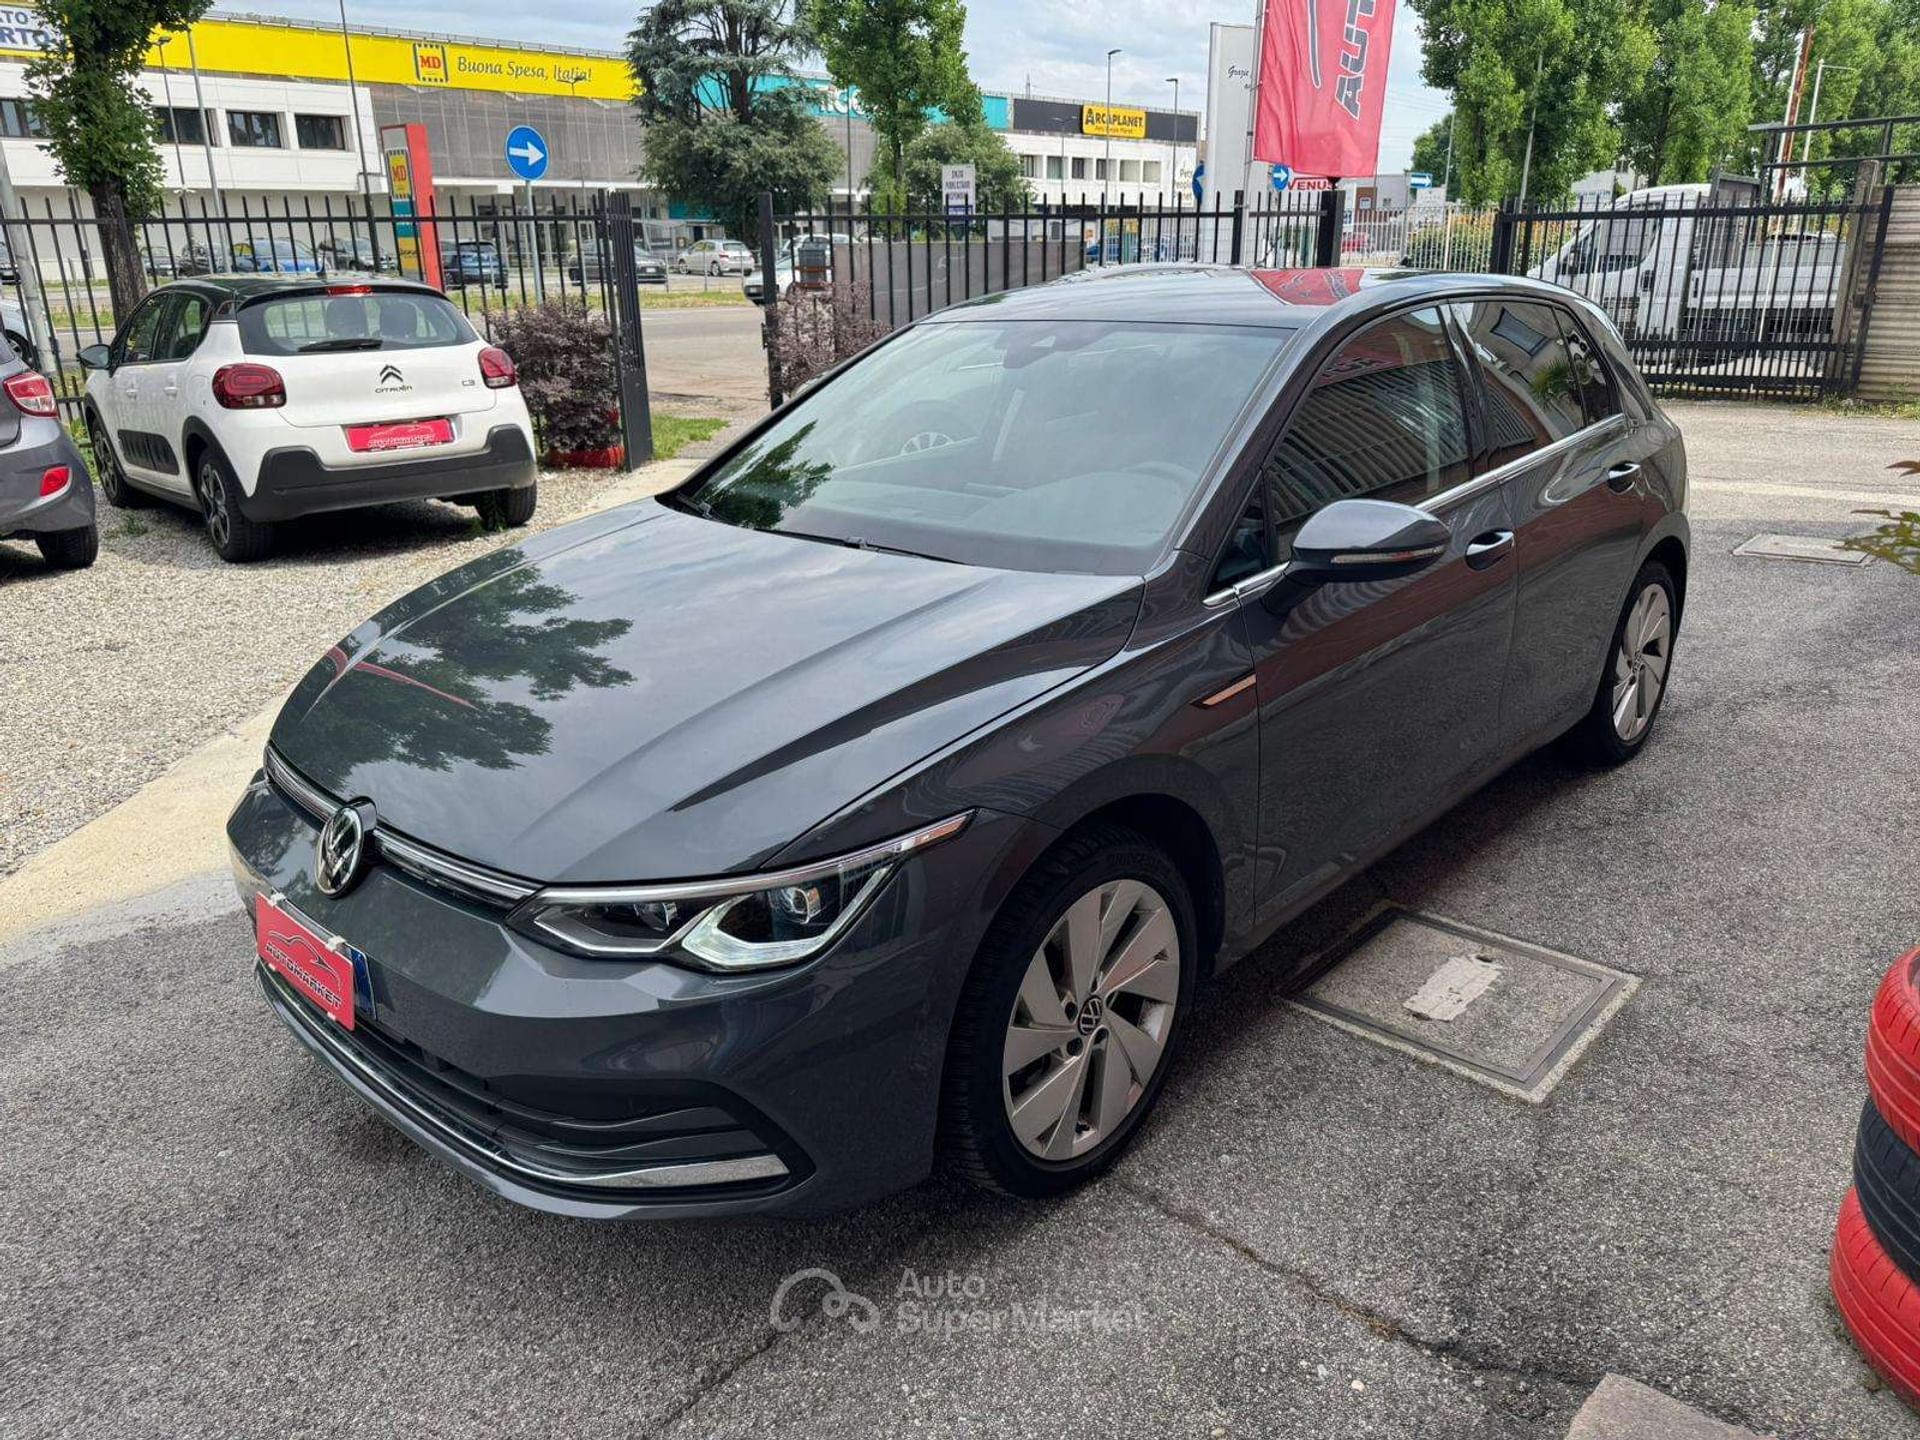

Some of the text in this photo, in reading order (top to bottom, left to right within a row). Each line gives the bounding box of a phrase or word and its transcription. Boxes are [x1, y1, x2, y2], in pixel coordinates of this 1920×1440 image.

[419, 54, 442, 70] MD
[457, 56, 593, 83] Buona Spesa, Italia!
[1085, 107, 1144, 129] ARCAPLANET
[391, 164, 407, 182] MD
[264, 940, 343, 1010] AUTOMARKET
